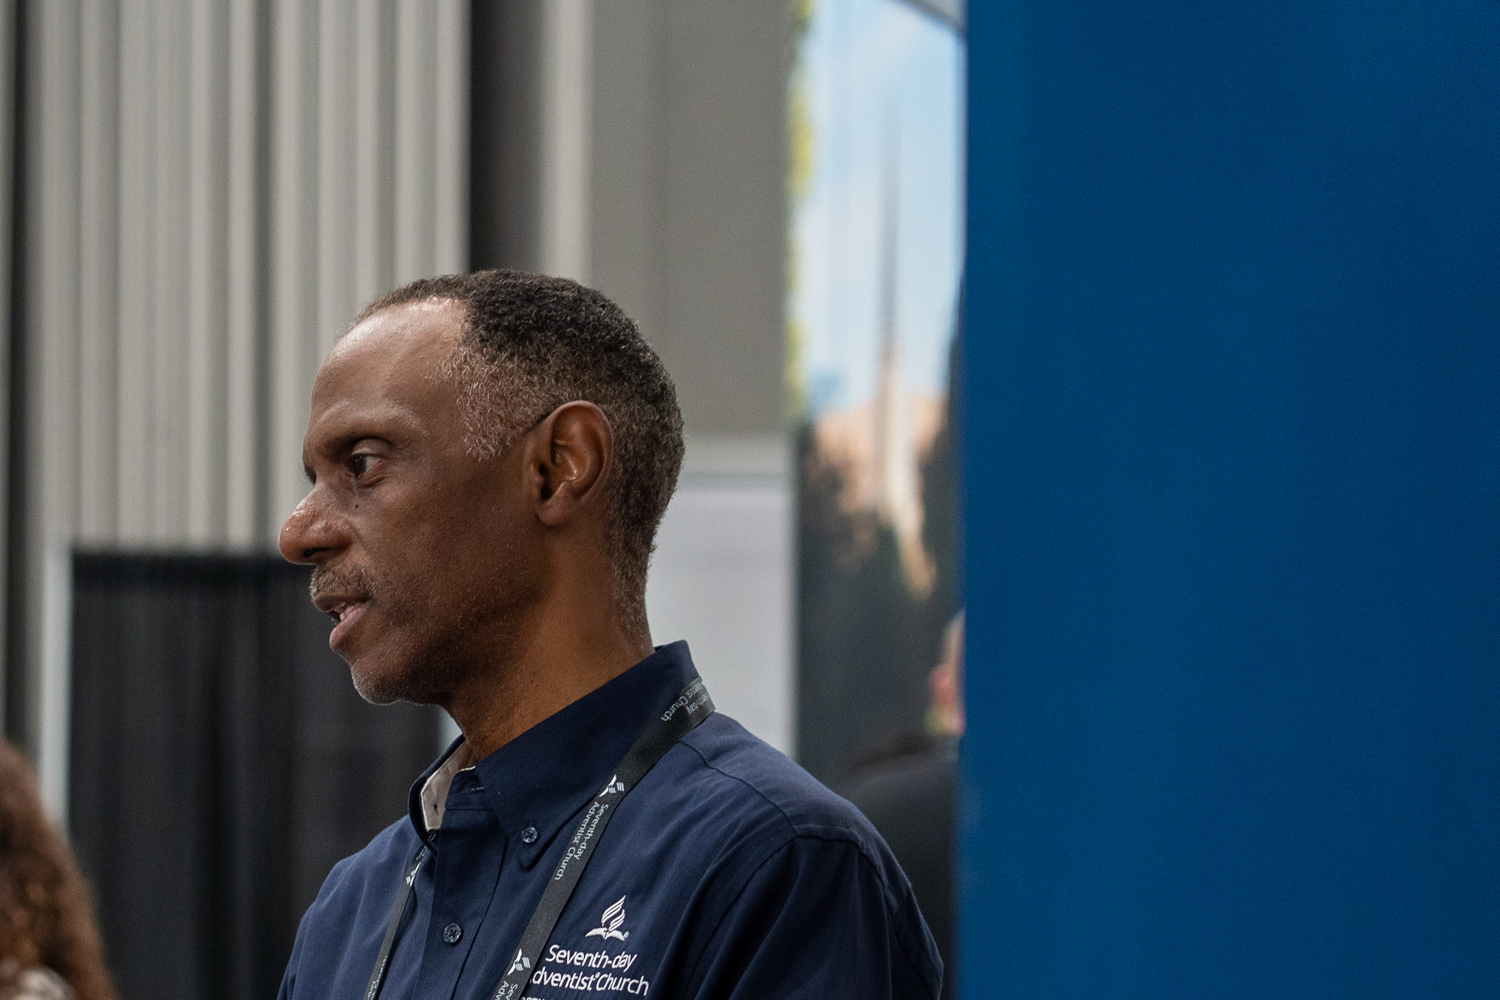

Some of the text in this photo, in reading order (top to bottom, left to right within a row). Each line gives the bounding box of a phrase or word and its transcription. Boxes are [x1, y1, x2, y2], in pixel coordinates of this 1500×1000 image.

[554, 801, 600, 881] Adventist Church
[574, 803, 609, 861] Seventh-day
[545, 944, 638, 973] Seventh-day
[530, 966, 650, 996] dventist Church
